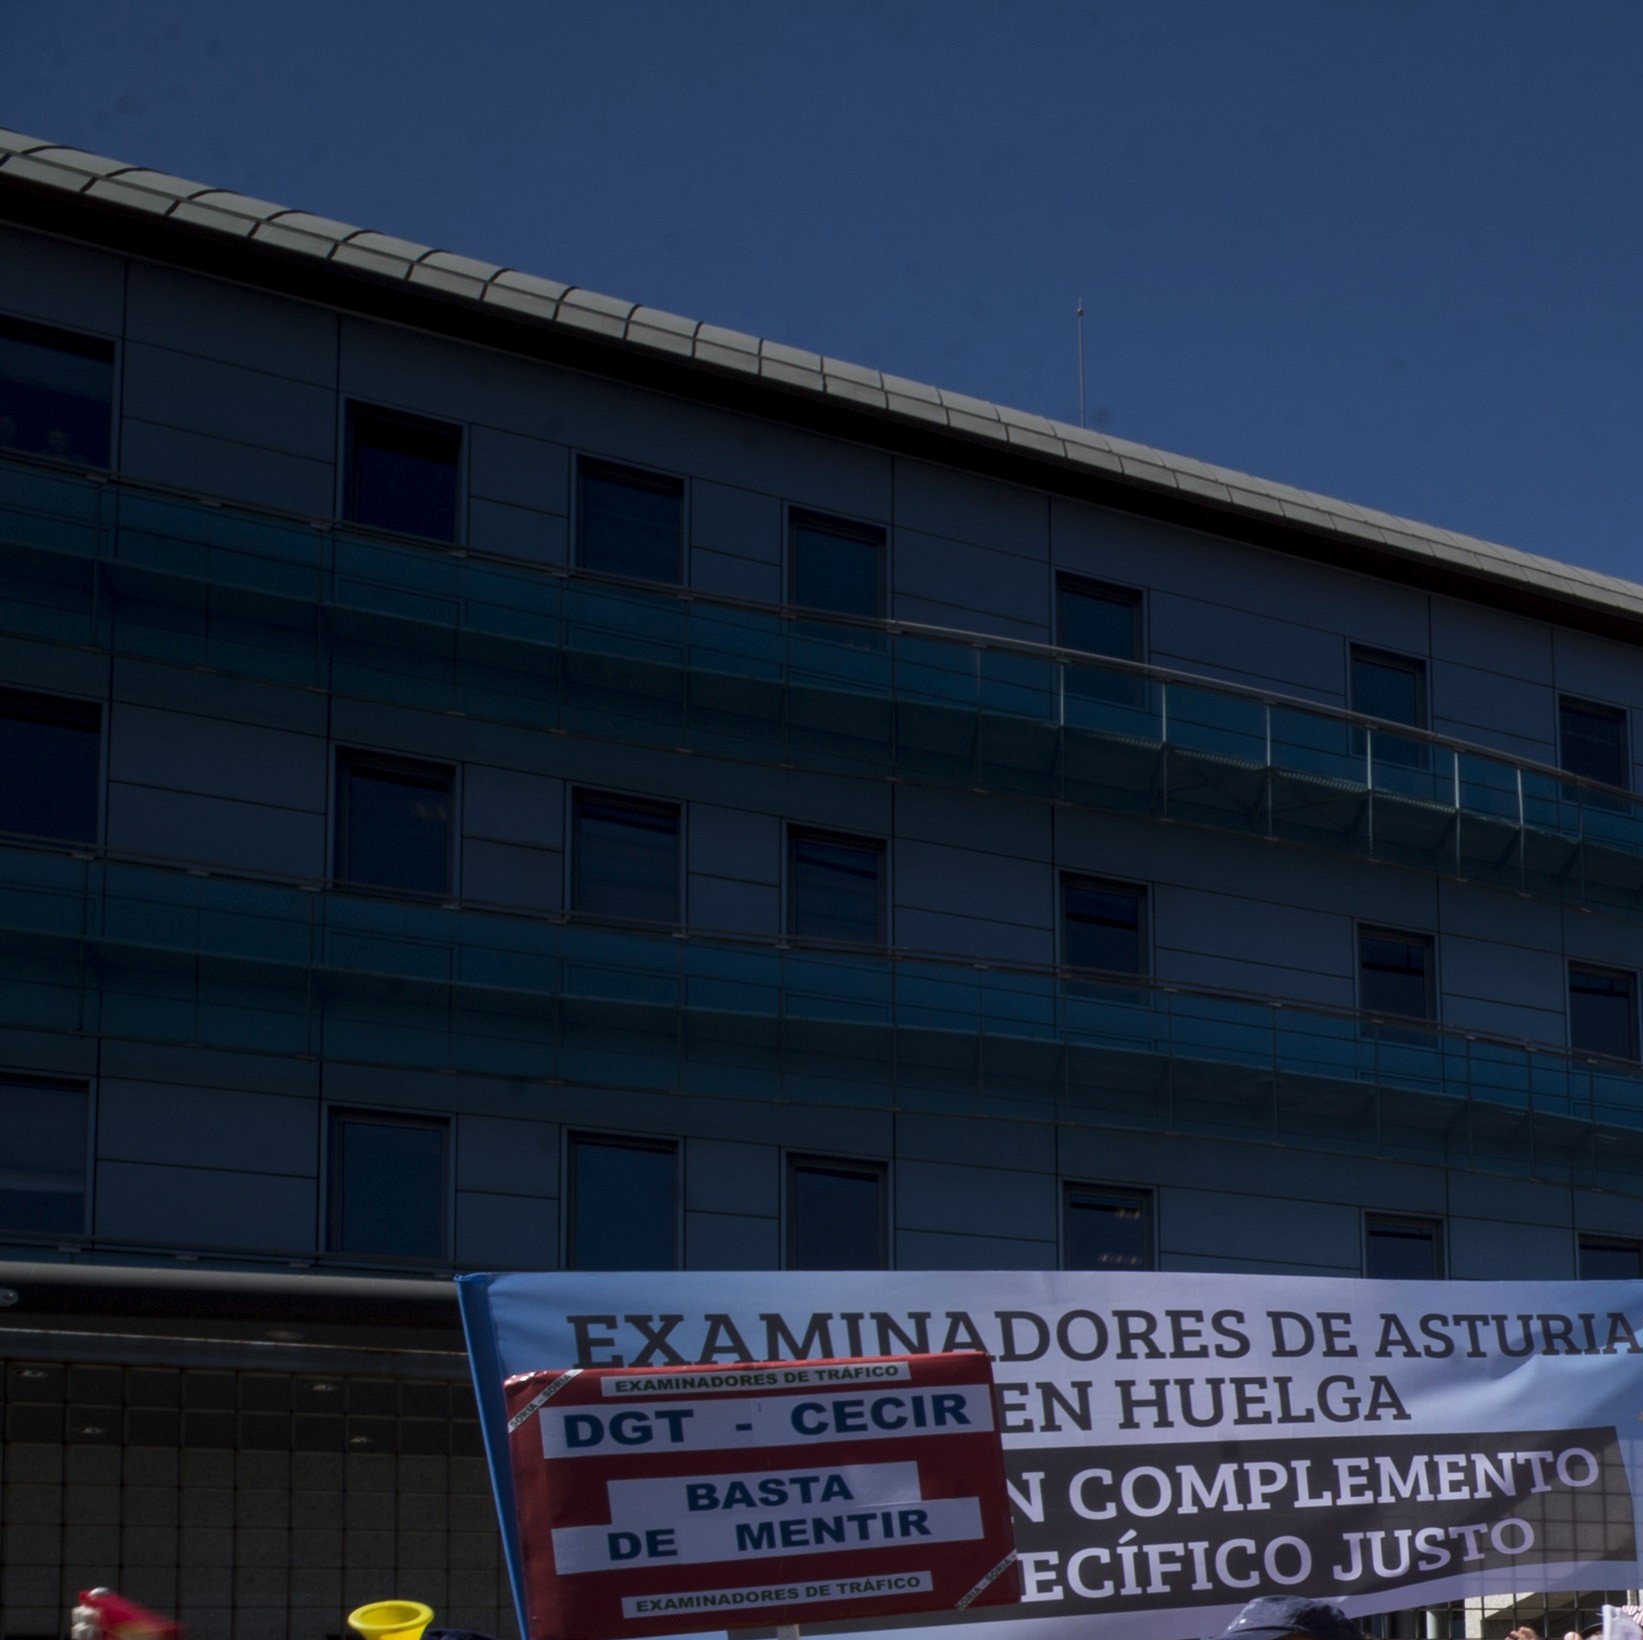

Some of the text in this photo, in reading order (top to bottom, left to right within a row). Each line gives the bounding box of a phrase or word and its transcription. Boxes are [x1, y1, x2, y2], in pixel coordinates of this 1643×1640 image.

[566, 1308, 1251, 1370] EXAMINADORES
[1265, 1311, 1358, 1359] DE
[614, 1362, 899, 1394] EXAMINADORES DE TRÁFICO
[995, 1374, 1412, 1434] EN HUELGA
[562, 1408, 694, 1449] DGT
[790, 1392, 972, 1437] CECIR
[685, 1472, 855, 1512] BASTA
[1068, 1446, 1601, 1521] COMPLEMENTO
[607, 1508, 933, 1562] DE MENTIR
[1333, 1516, 1537, 1583] JUSTO
[635, 1575, 922, 1613] EXAMINADORES DE TRÁFICO
